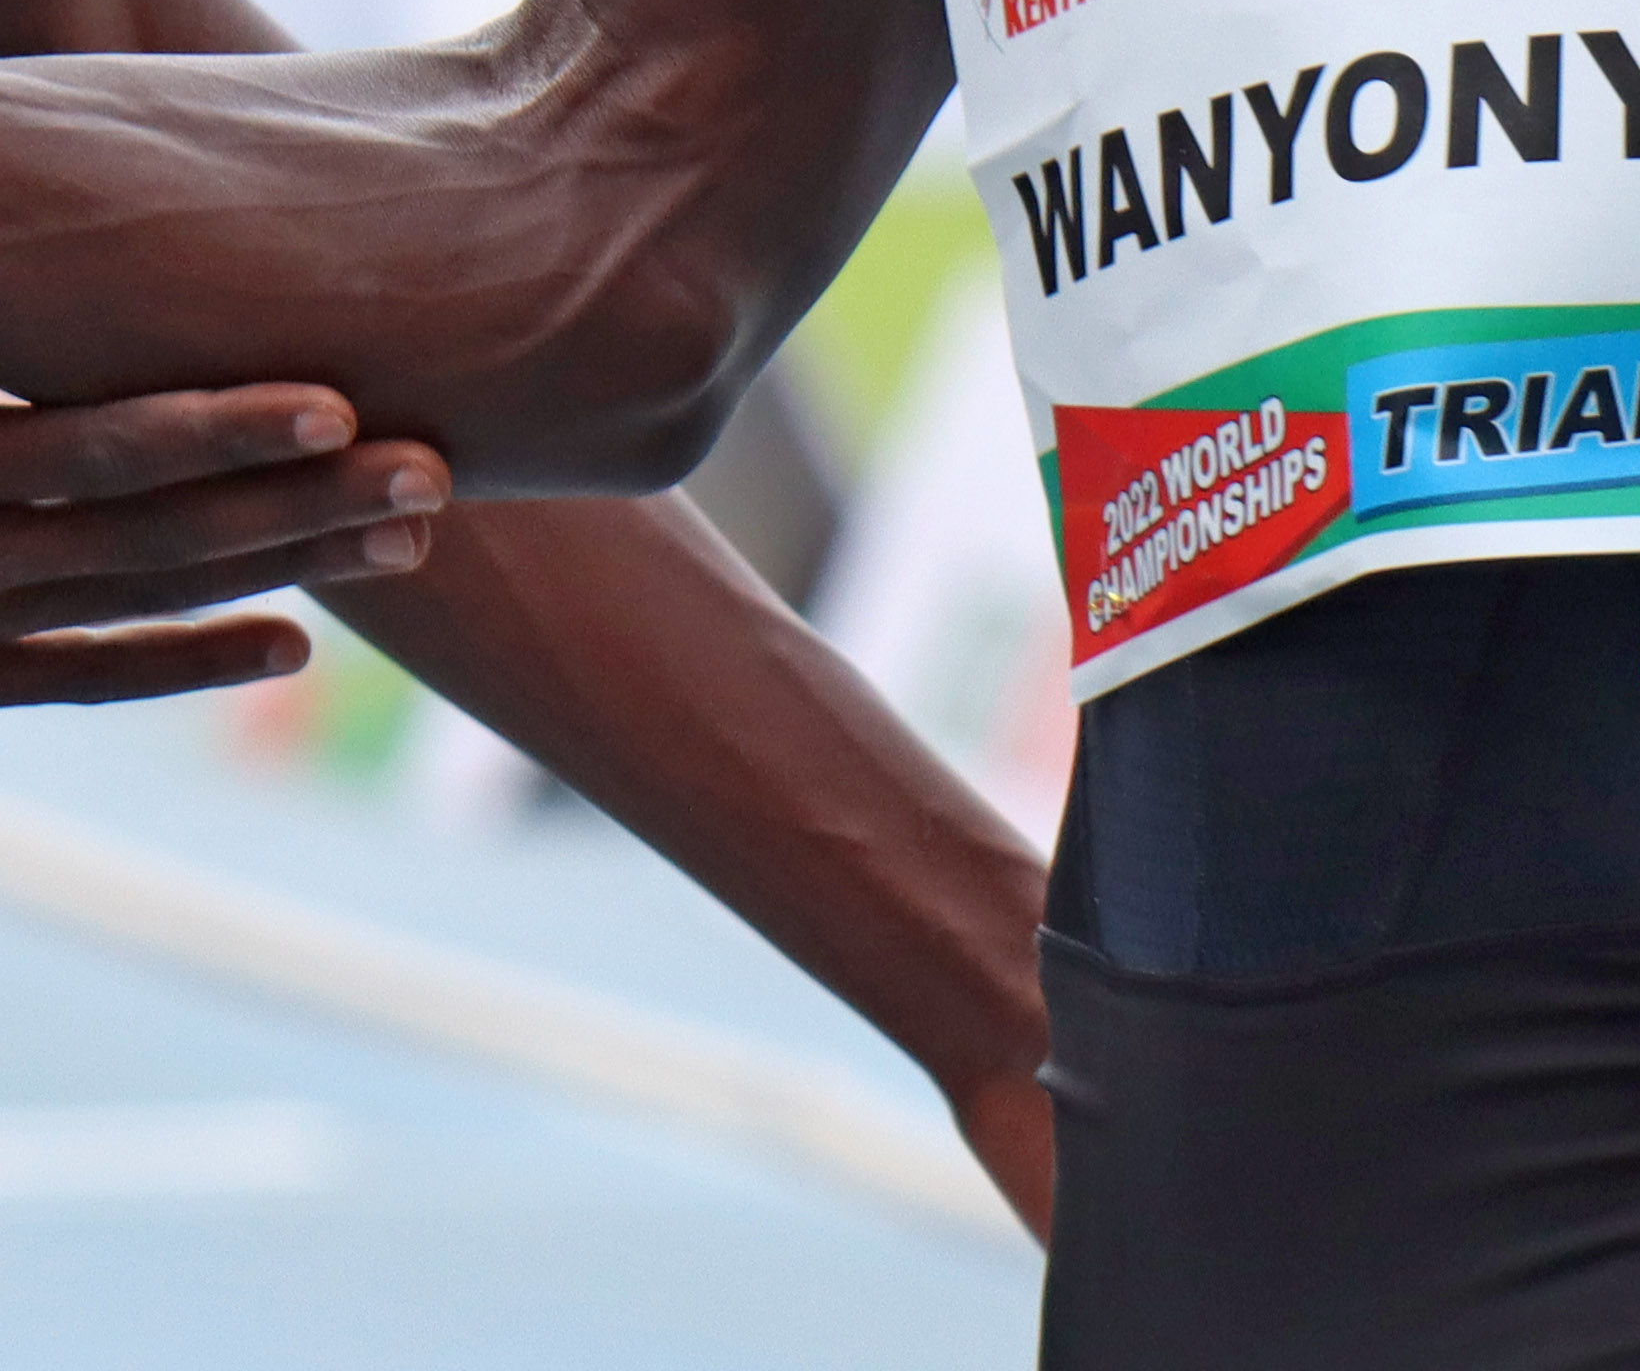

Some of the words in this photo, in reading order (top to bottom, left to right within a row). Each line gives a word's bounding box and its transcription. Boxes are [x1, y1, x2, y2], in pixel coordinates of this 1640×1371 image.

[1087, 436, 1327, 634] CHAMPIONSHIPS
[1102, 469, 1163, 557] 2022
[1160, 395, 1286, 507] WORLD
